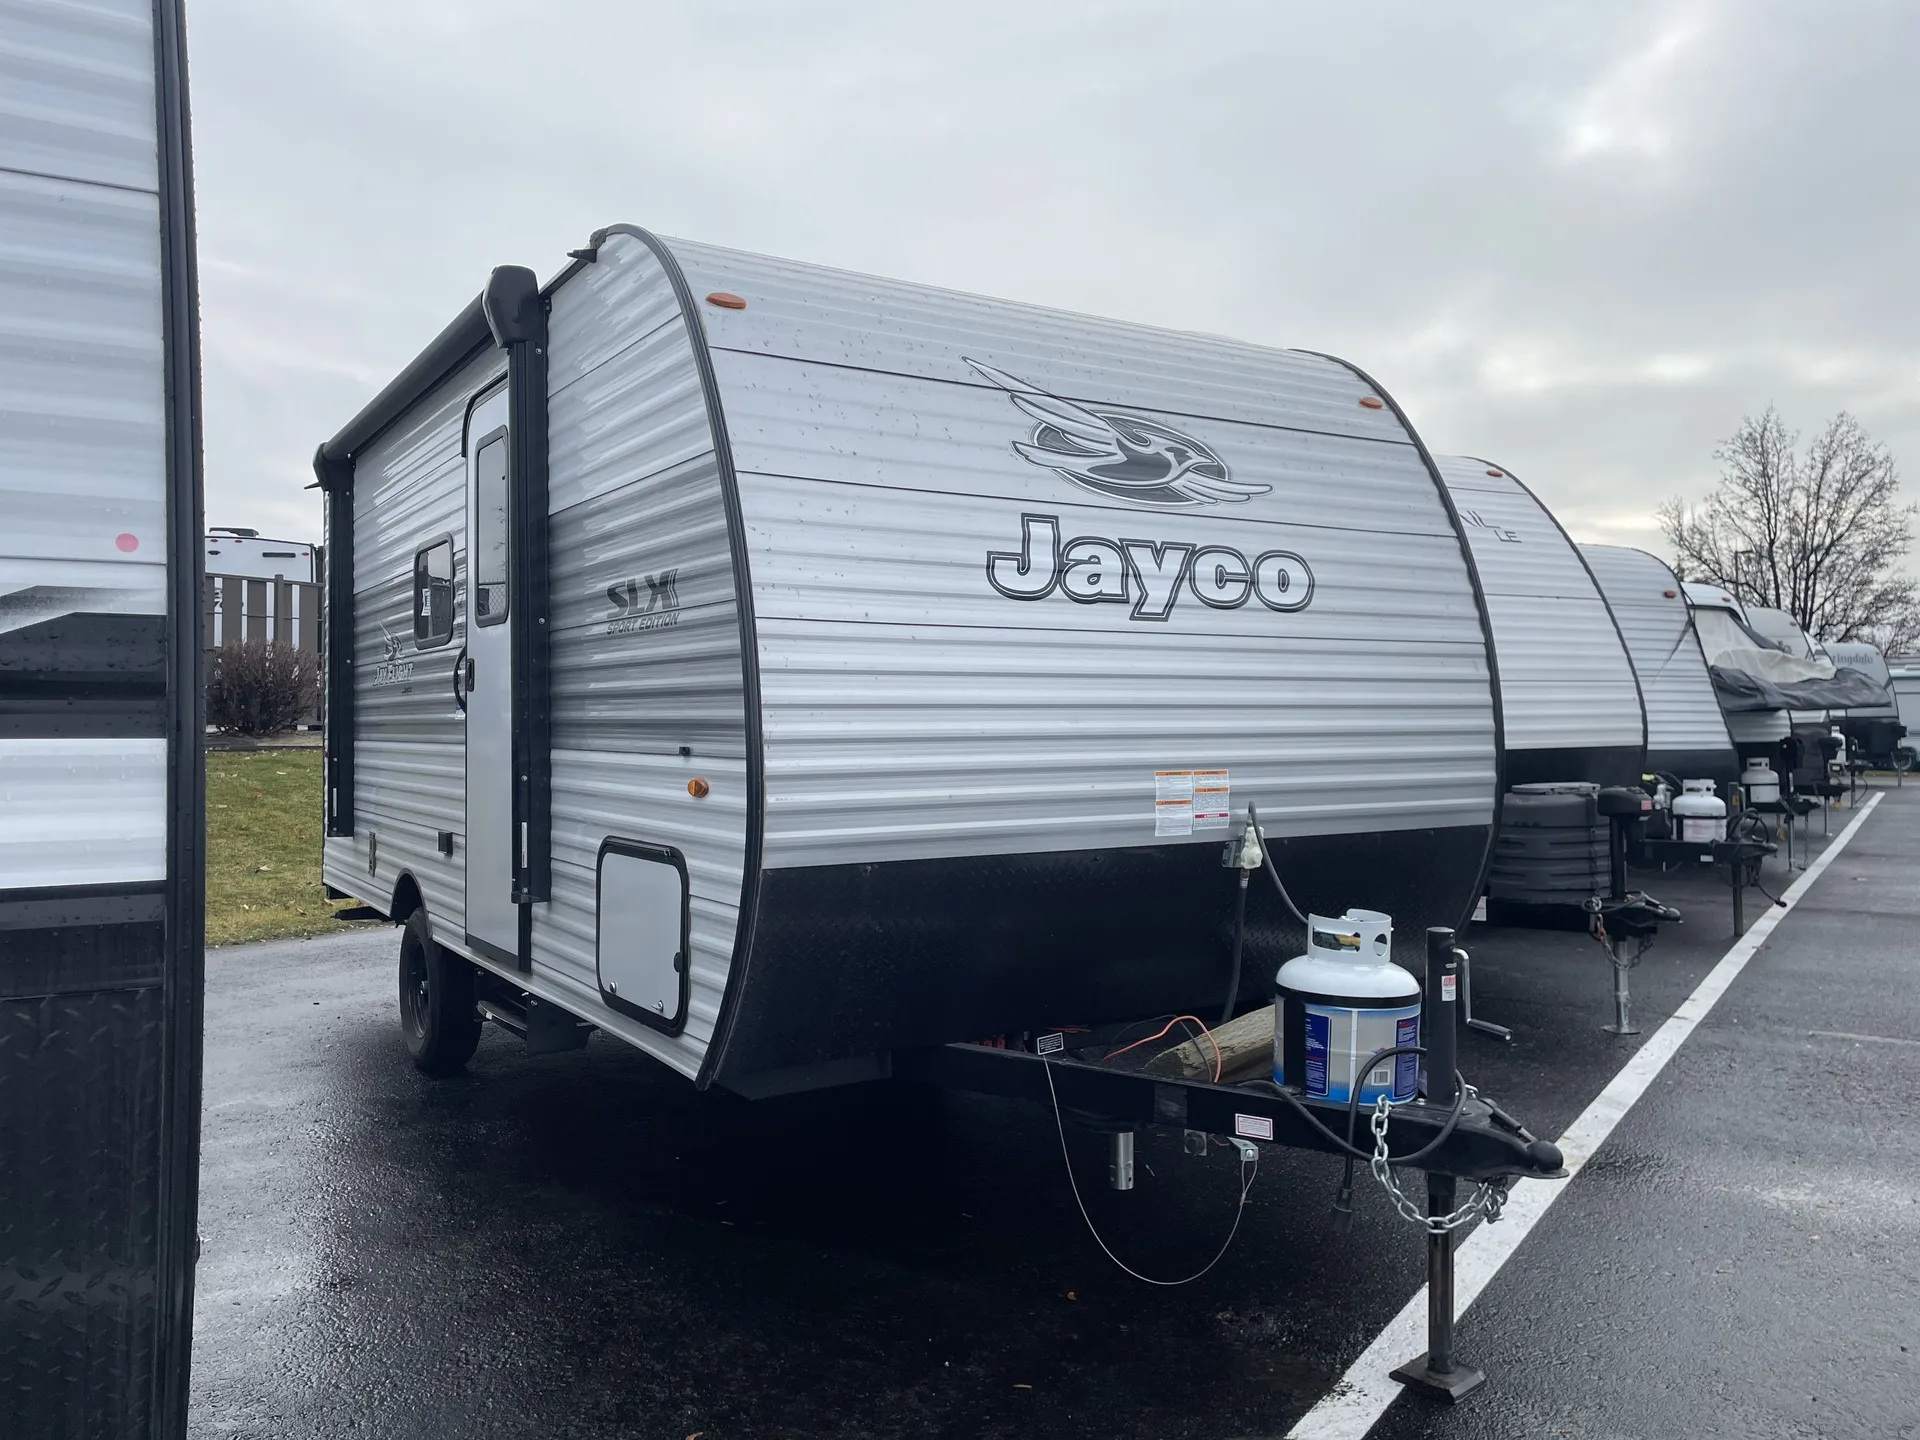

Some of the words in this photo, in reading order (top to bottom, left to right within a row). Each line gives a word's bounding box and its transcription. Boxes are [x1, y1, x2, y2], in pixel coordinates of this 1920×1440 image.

[986, 512, 1315, 622] Jayco
[606, 568, 680, 619] SLX
[606, 620, 638, 635] SPORT
[638, 612, 680, 630] EDITION
[1832, 652, 1873, 666] ringdale
